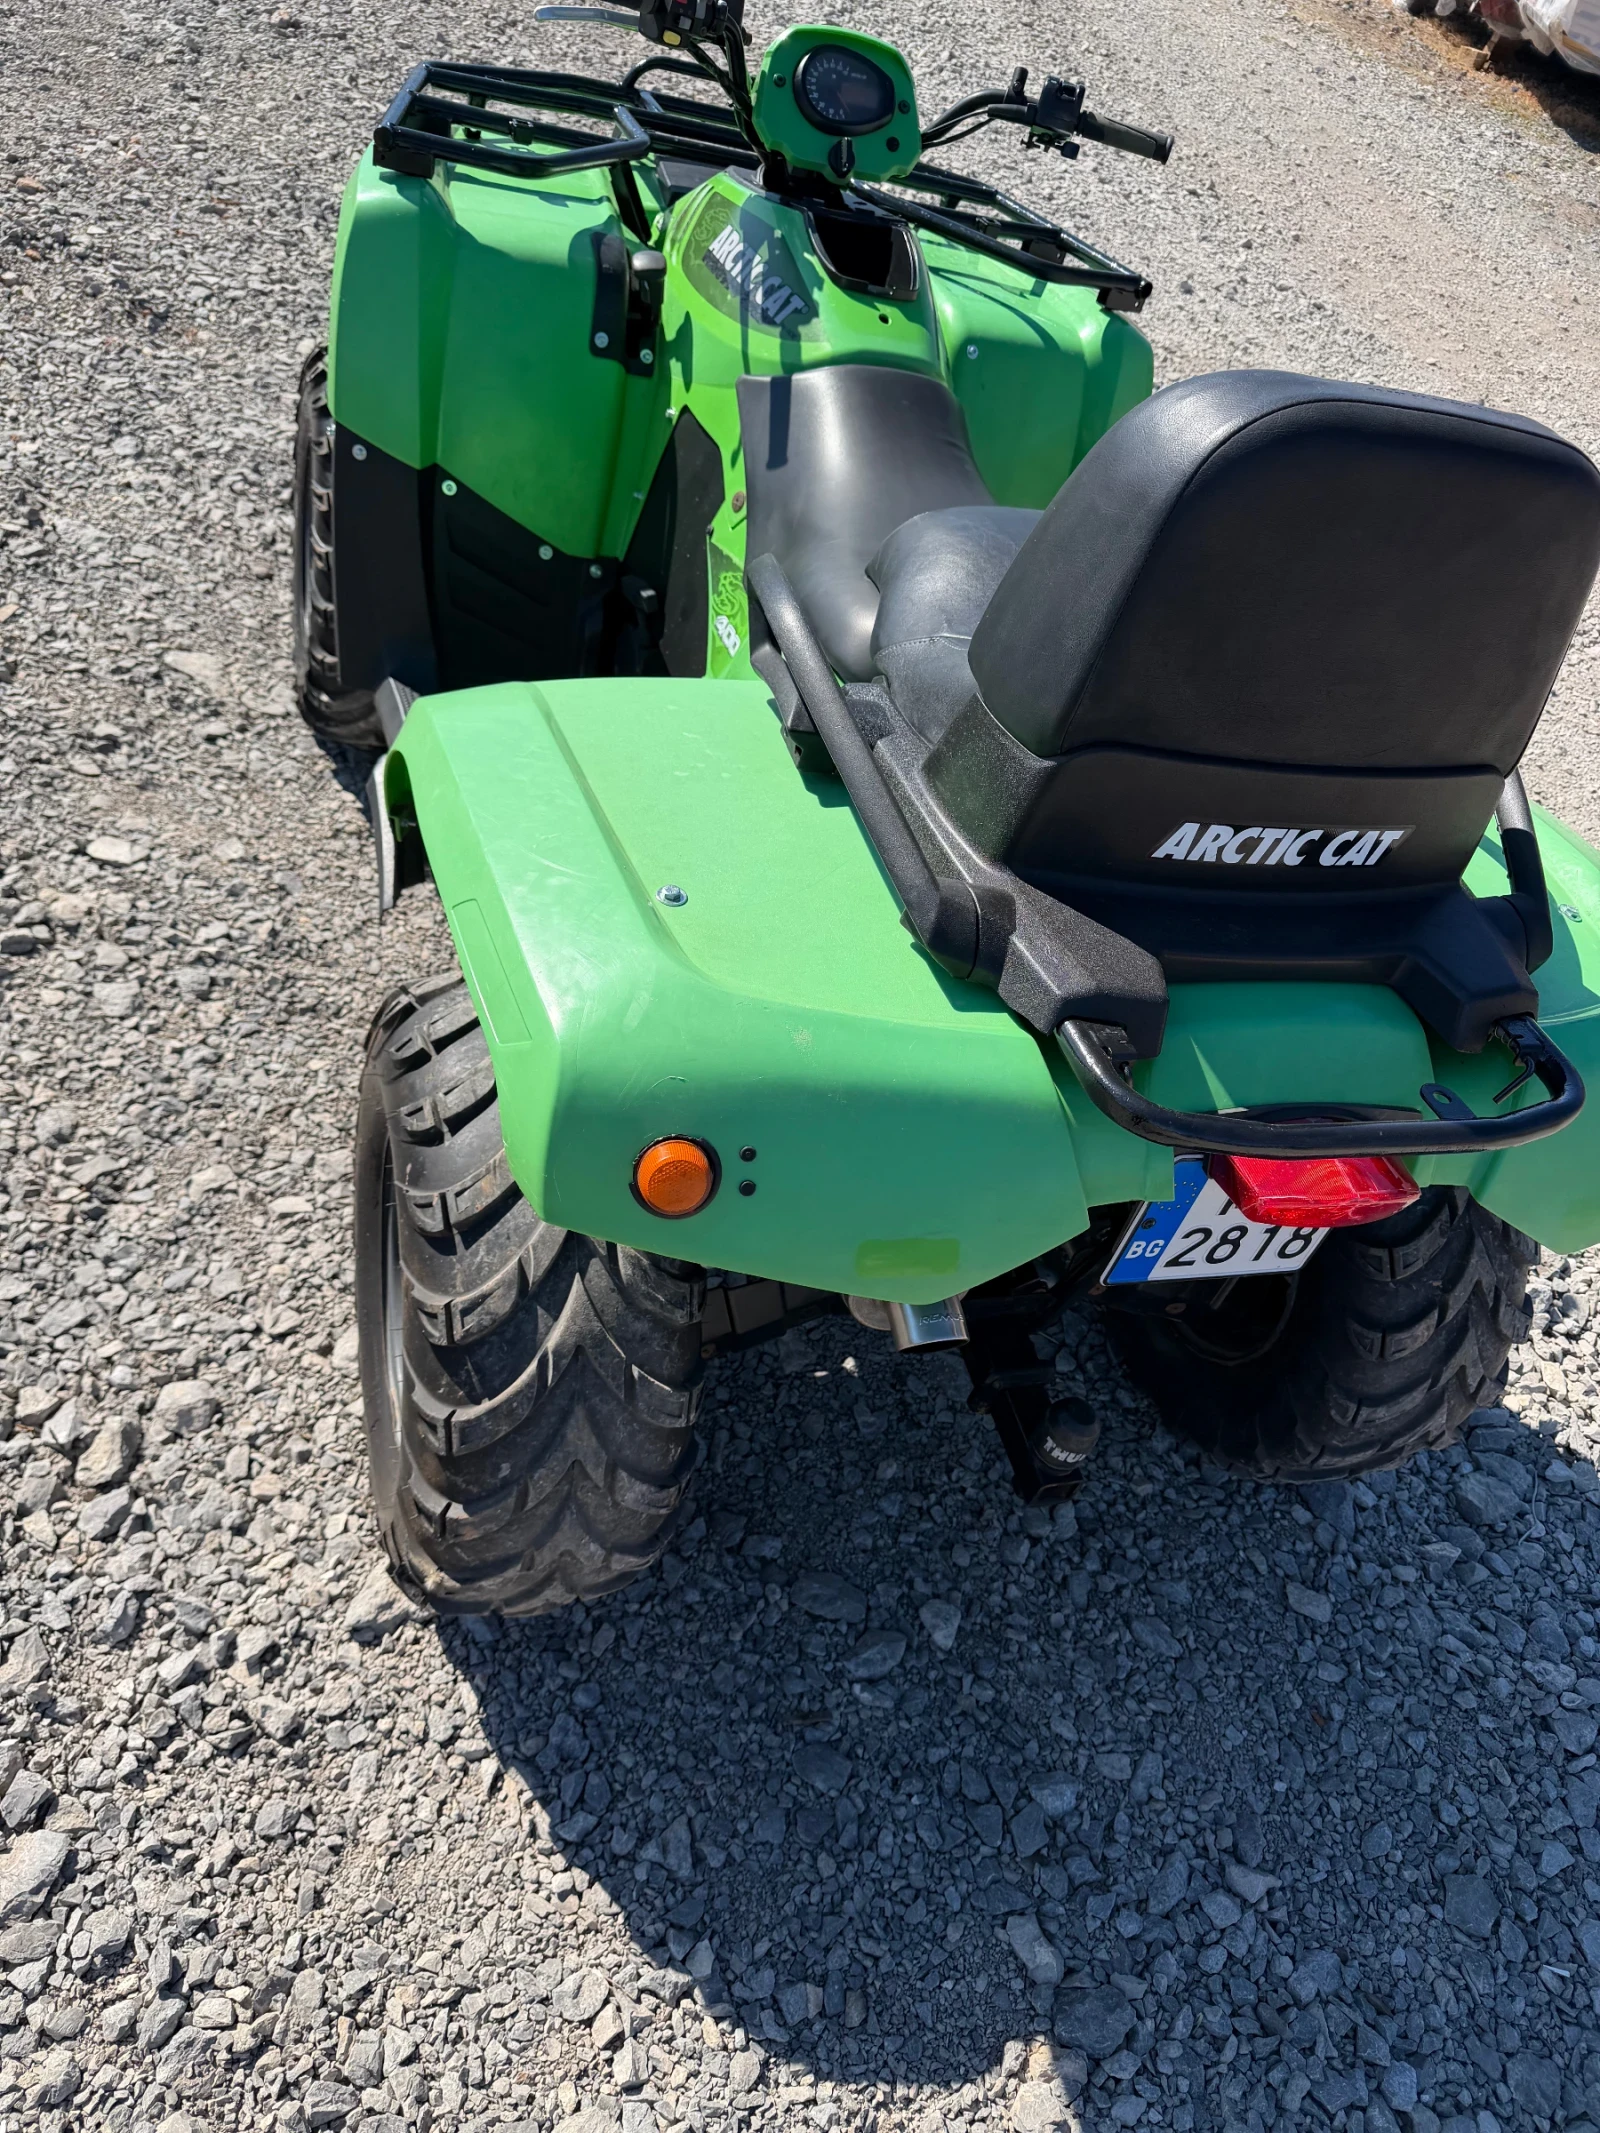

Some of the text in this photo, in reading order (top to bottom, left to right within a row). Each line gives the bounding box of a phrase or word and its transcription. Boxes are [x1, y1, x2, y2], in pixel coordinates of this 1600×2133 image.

[708, 224, 806, 325] ARCTIC CAT
[714, 614, 741, 658] 400
[1150, 822, 1405, 867] ARCTIC CAT
[1124, 1225, 1318, 1268] BG 2818
